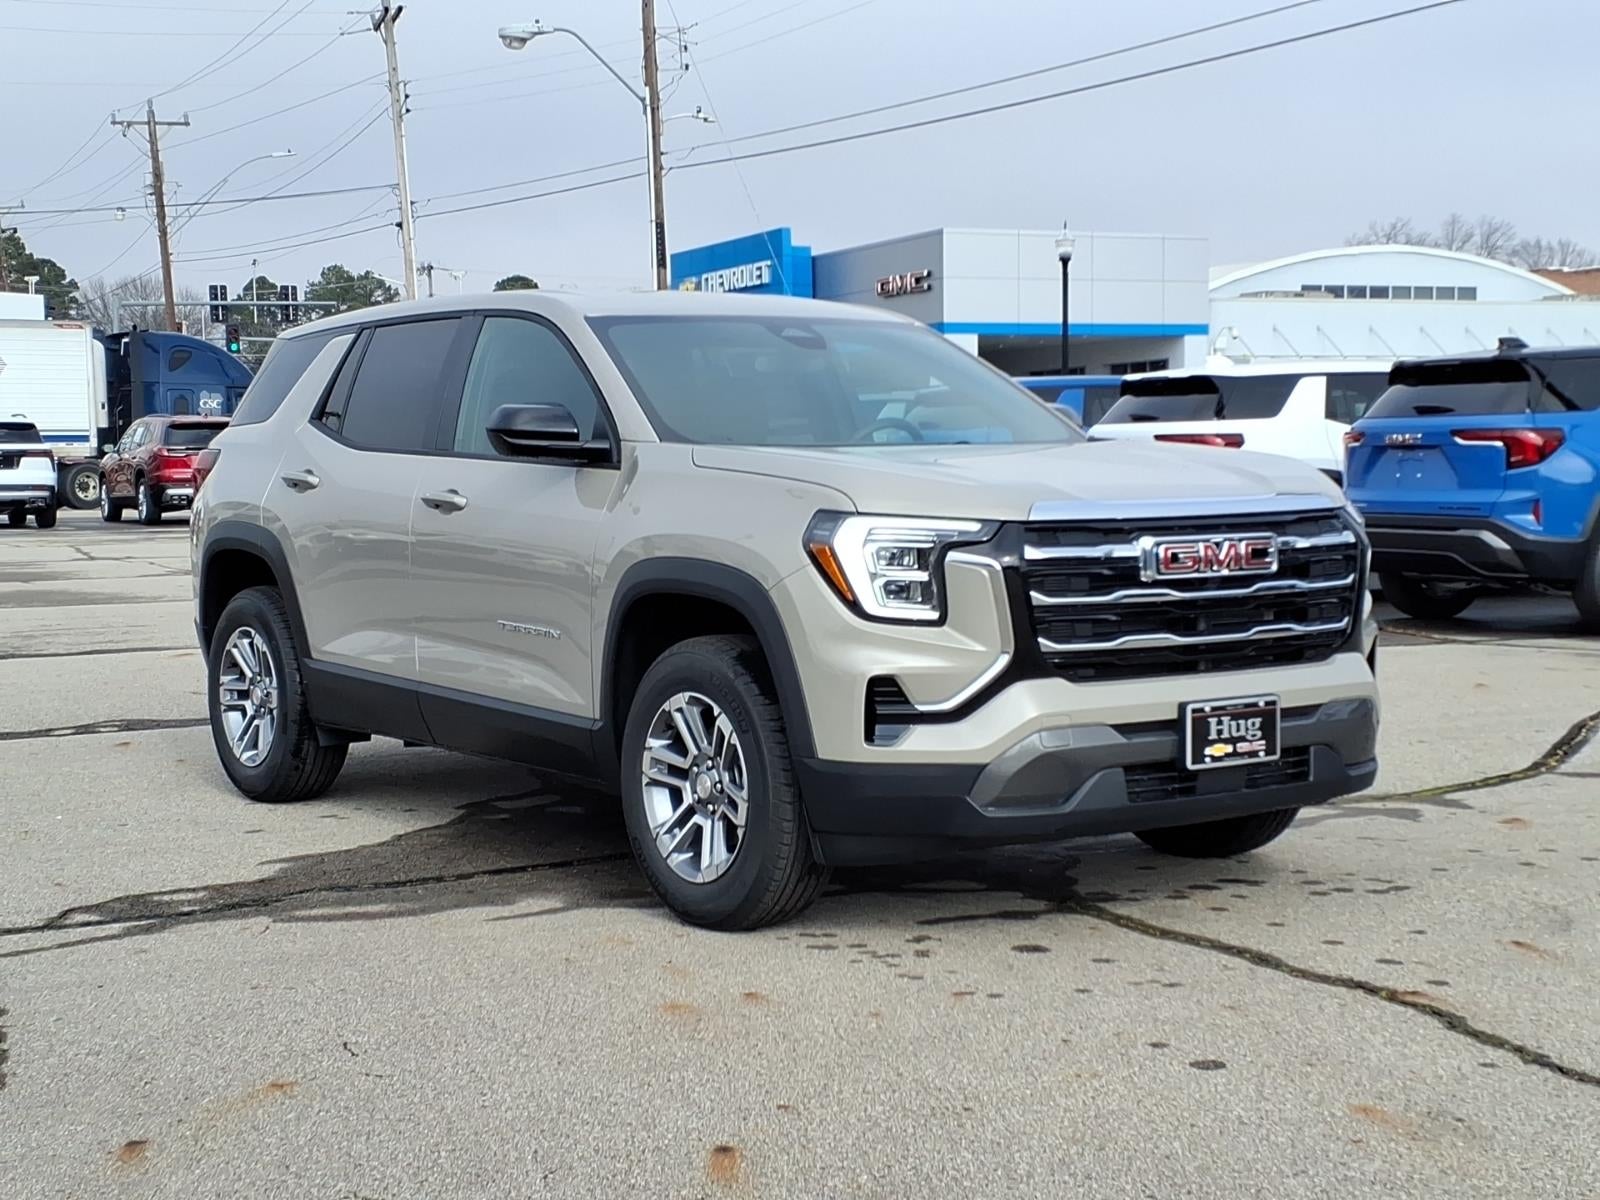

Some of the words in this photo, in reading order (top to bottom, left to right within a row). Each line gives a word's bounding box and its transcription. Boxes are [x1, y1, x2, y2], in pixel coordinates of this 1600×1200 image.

[701, 260, 771, 293] CHEVROLET
[876, 269, 931, 298] GMC
[1160, 540, 1274, 574] GMC
[1207, 716, 1262, 740] Hug
